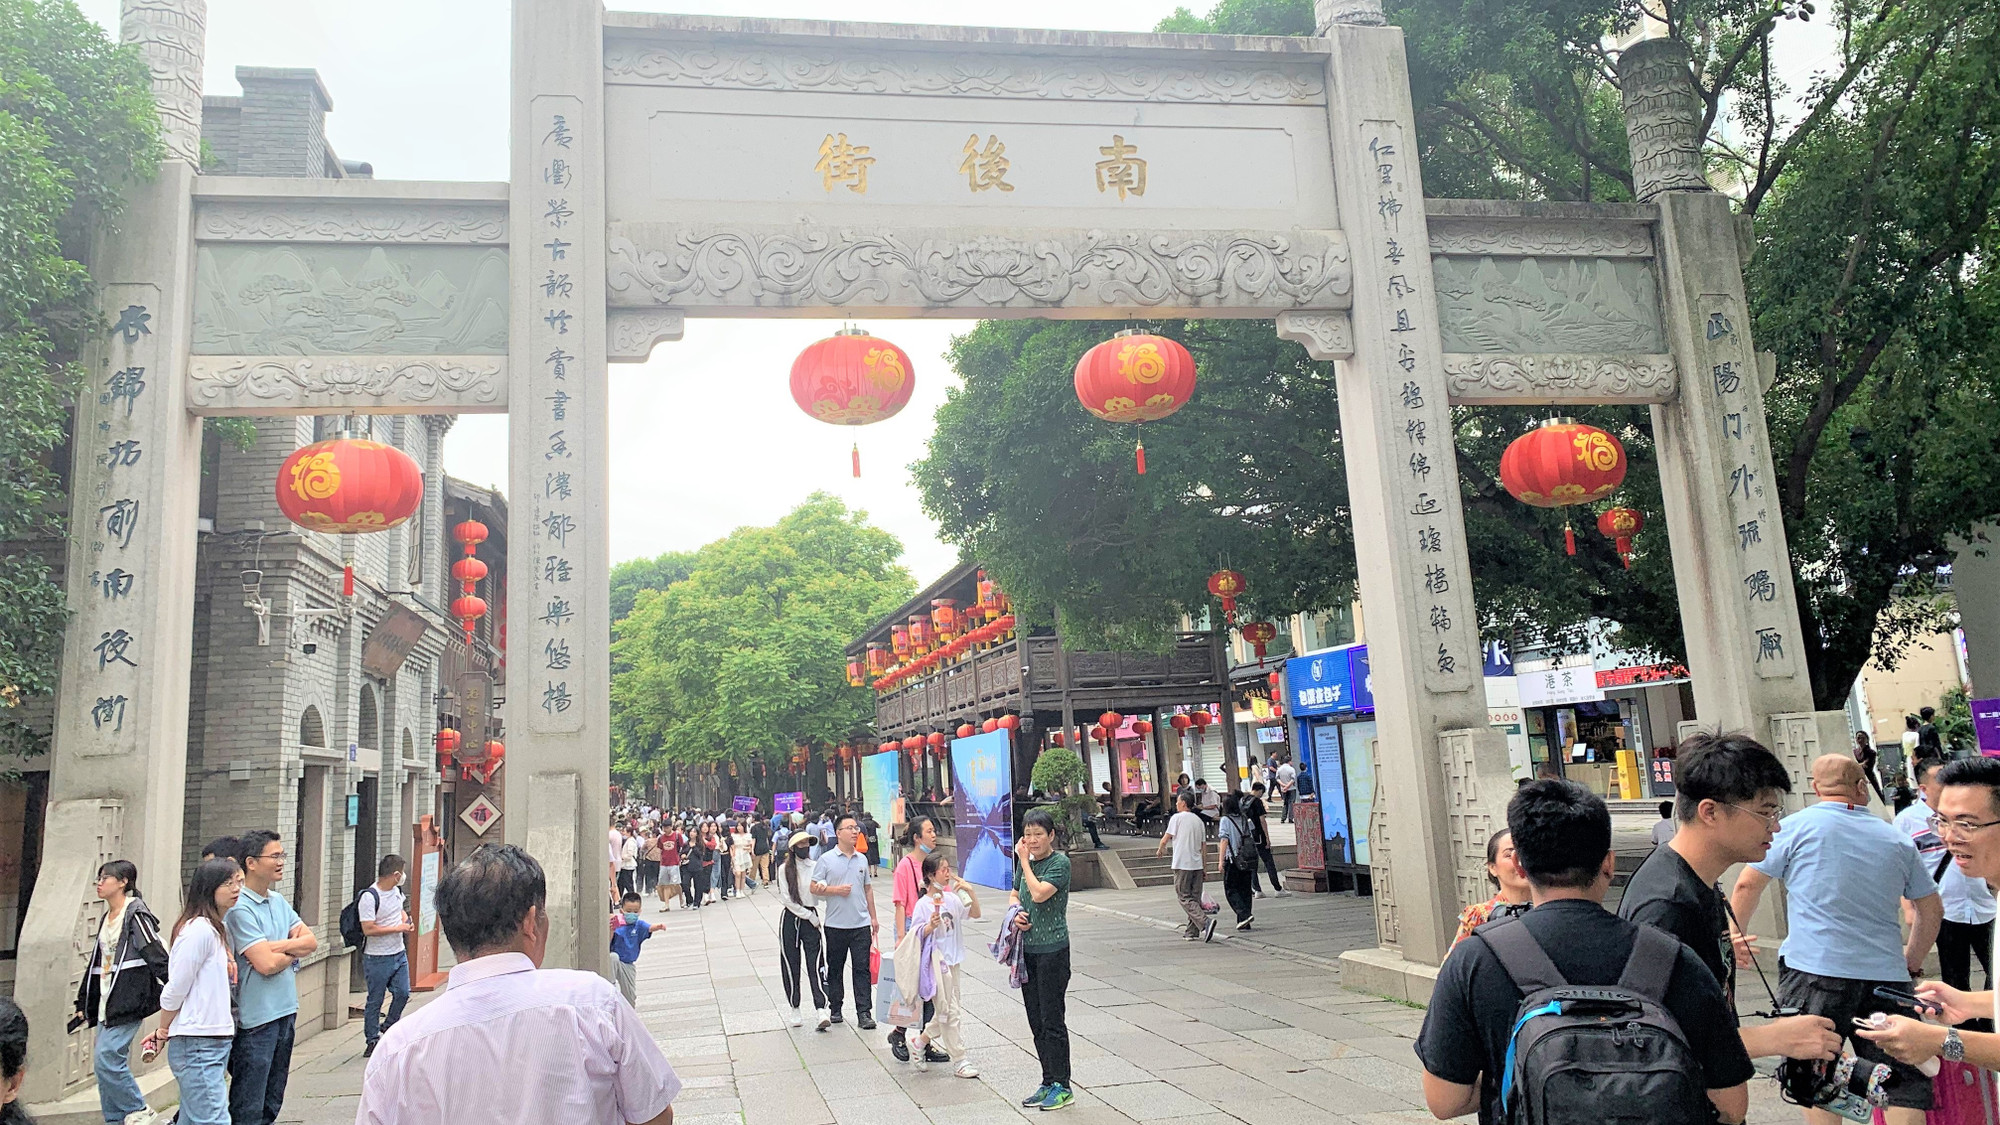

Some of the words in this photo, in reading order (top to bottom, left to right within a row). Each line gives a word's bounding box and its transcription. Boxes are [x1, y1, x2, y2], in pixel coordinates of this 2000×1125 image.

[815, 132, 1147, 201] 南後街
[1544, 671, 1573, 689] 港茶
